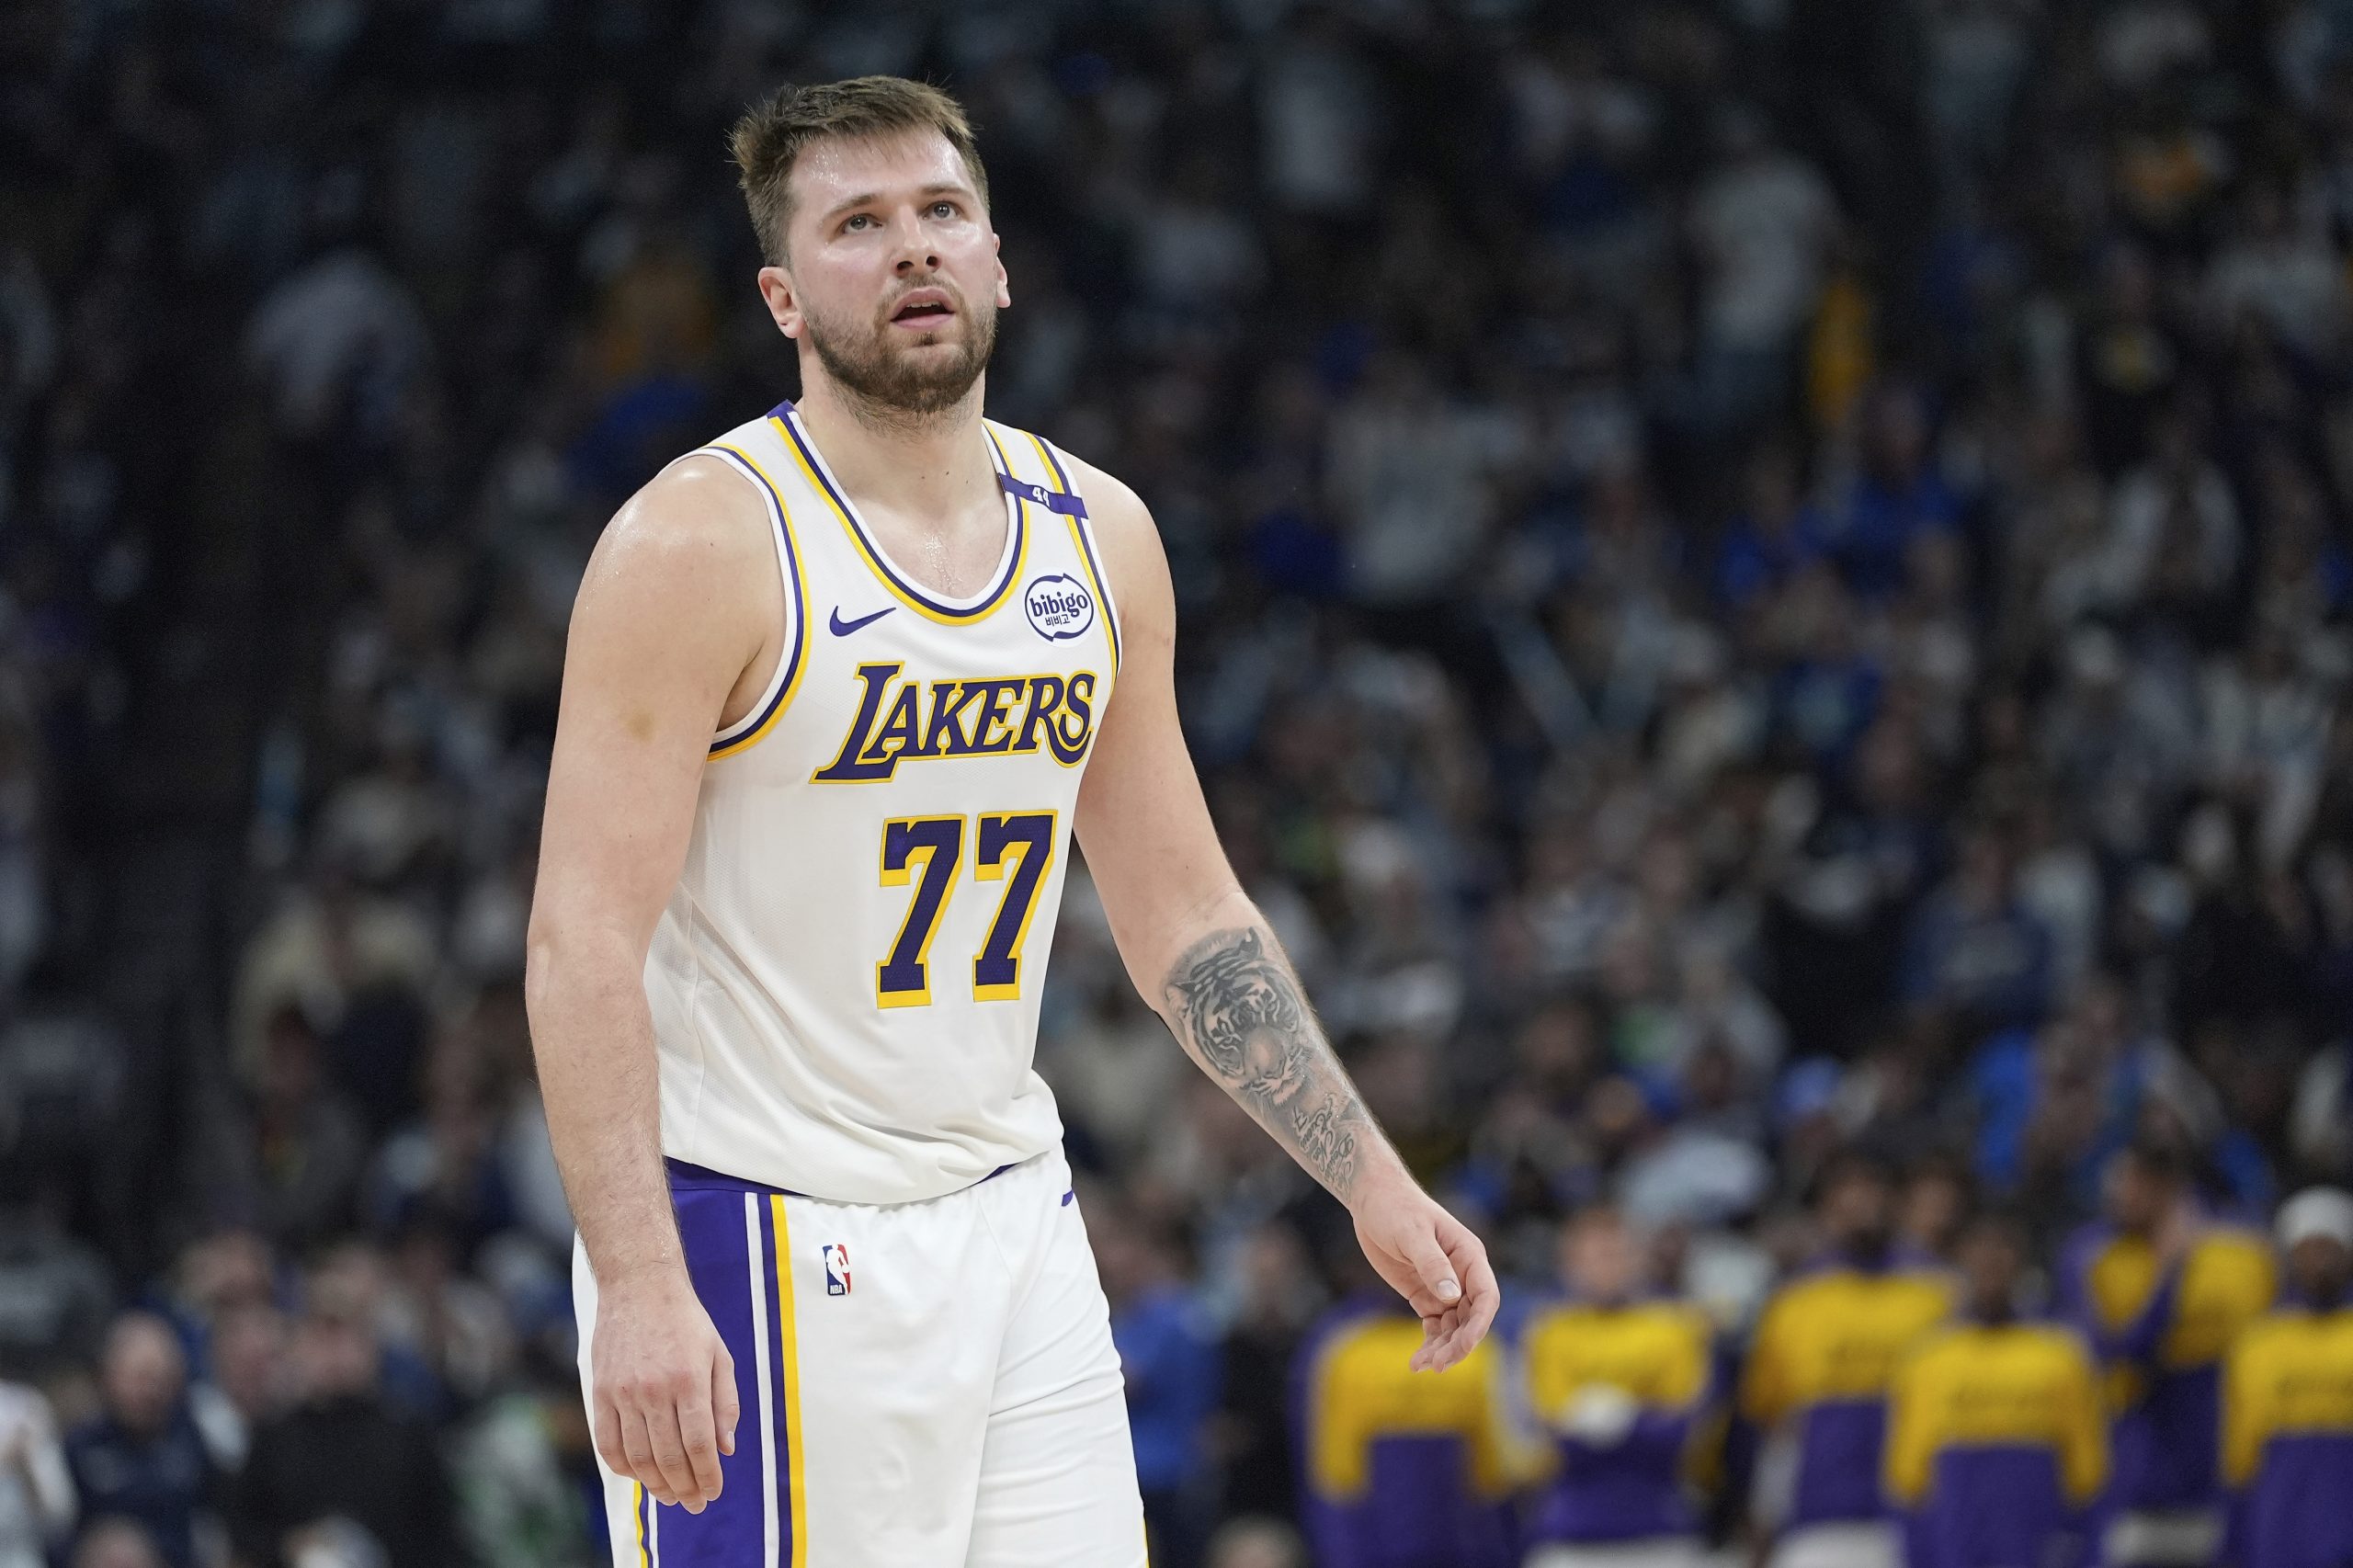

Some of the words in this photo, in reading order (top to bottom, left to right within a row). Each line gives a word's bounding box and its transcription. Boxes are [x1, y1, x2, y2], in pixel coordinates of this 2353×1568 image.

[1032, 486, 1050, 507] 44
[1029, 591, 1088, 618] bibigo
[1045, 614, 1070, 627] 비비고
[809, 661, 1098, 784] LAKERS
[876, 809, 1058, 1009] 77
[830, 1284, 843, 1294] NBA
